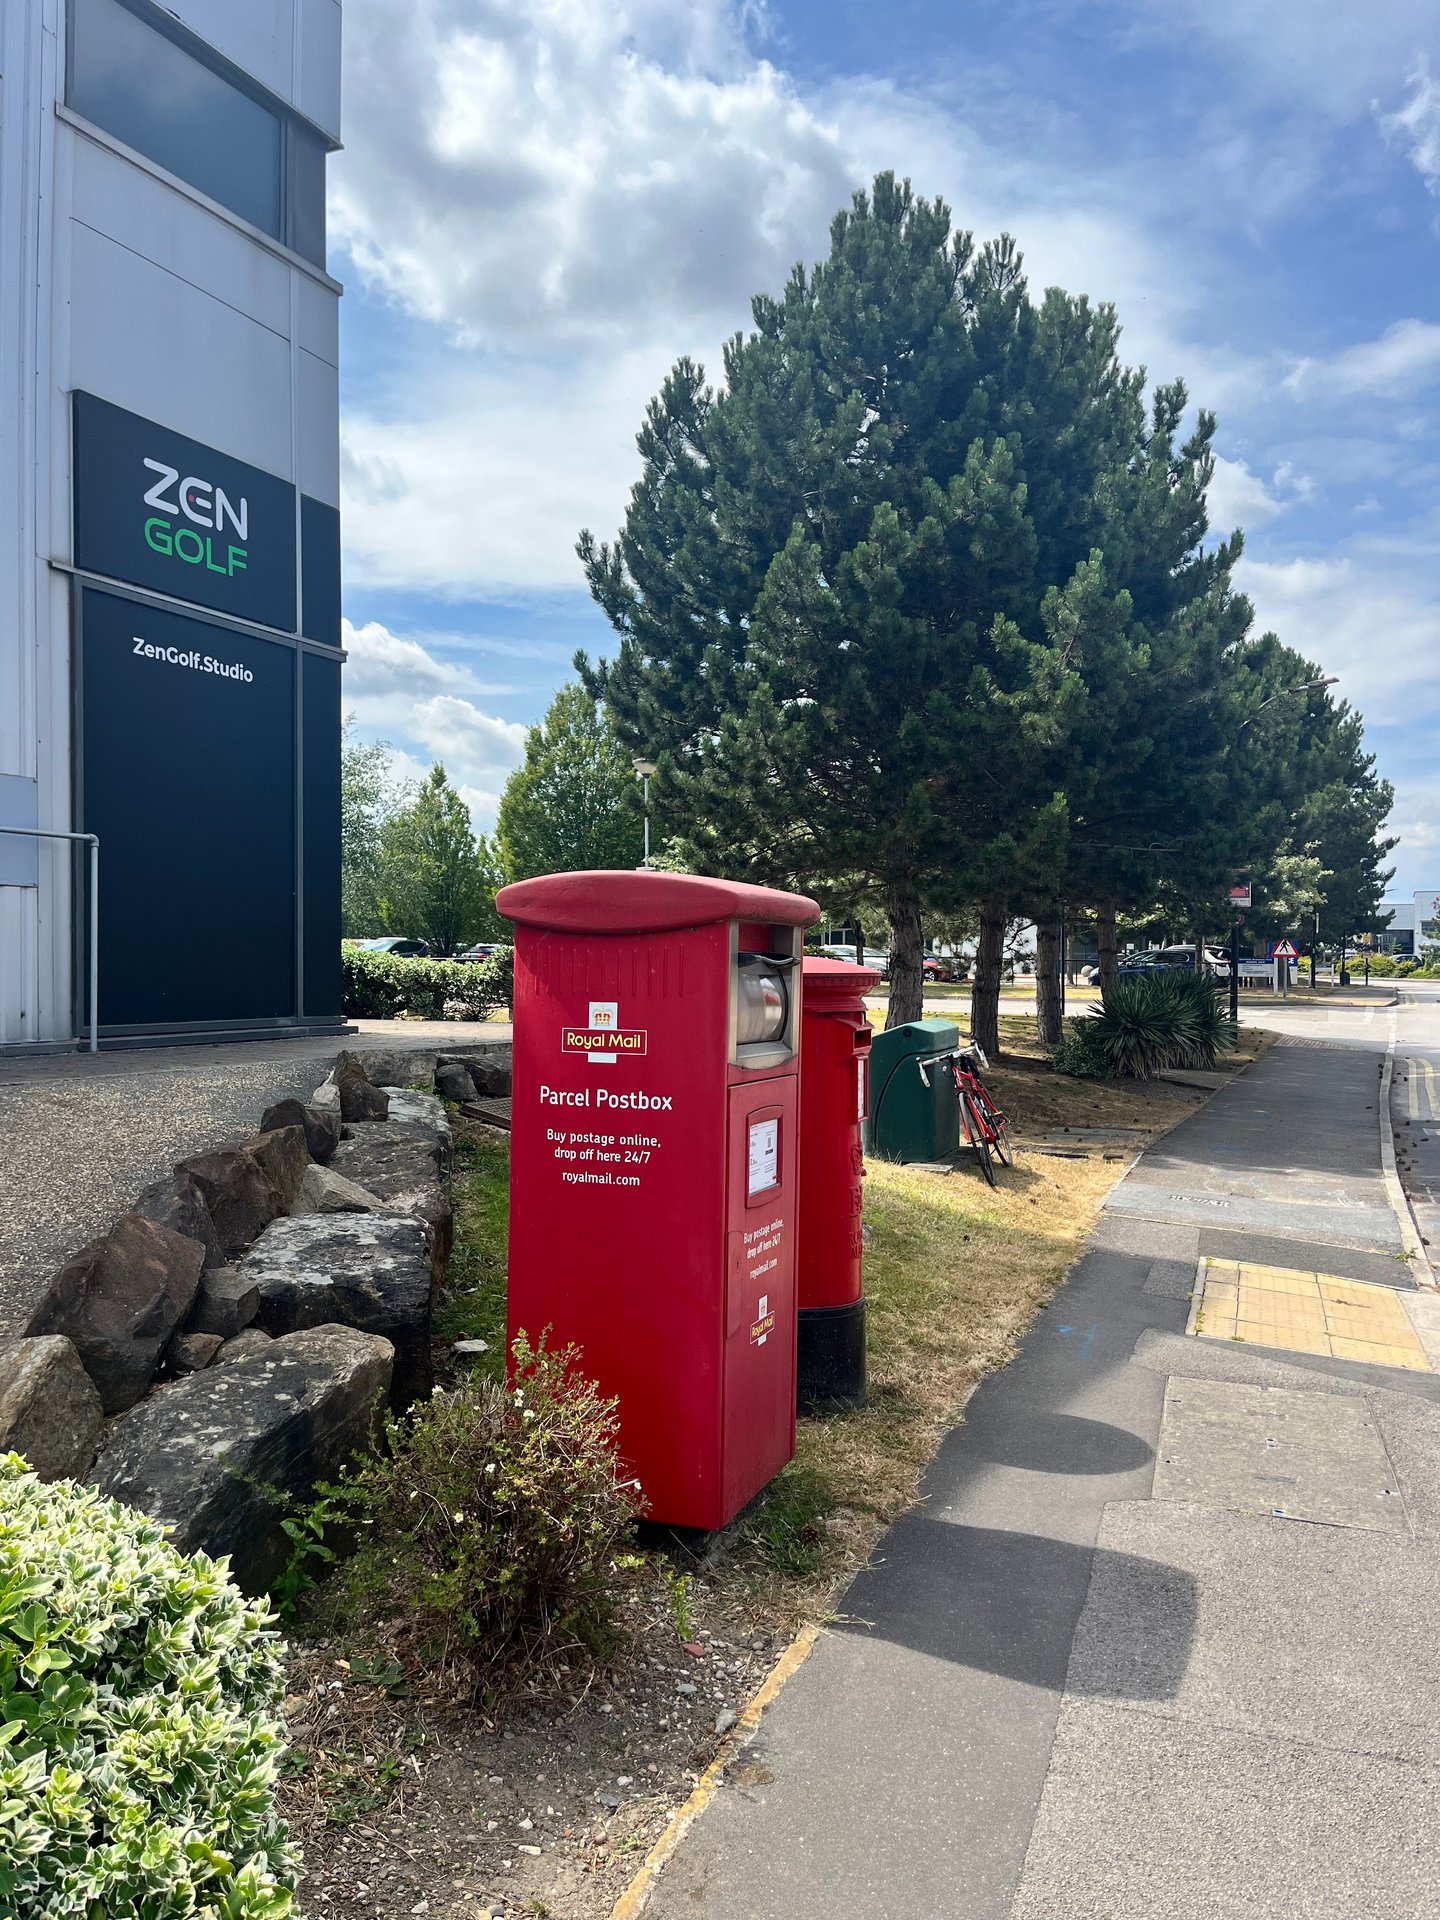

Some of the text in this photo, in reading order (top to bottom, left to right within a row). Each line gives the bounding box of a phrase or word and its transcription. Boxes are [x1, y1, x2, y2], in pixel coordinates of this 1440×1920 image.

[143, 457, 247, 541] ZEN
[144, 517, 247, 577] GOLF
[132, 636, 253, 683] ZenGolf.Studio
[567, 1032, 641, 1050] Royal Mail
[540, 1085, 673, 1111] Parcel Postbox
[547, 1128, 661, 1148] Buy postage online,
[554, 1146, 651, 1164] drop off here 24/7
[562, 1171, 640, 1186] royalmail.com
